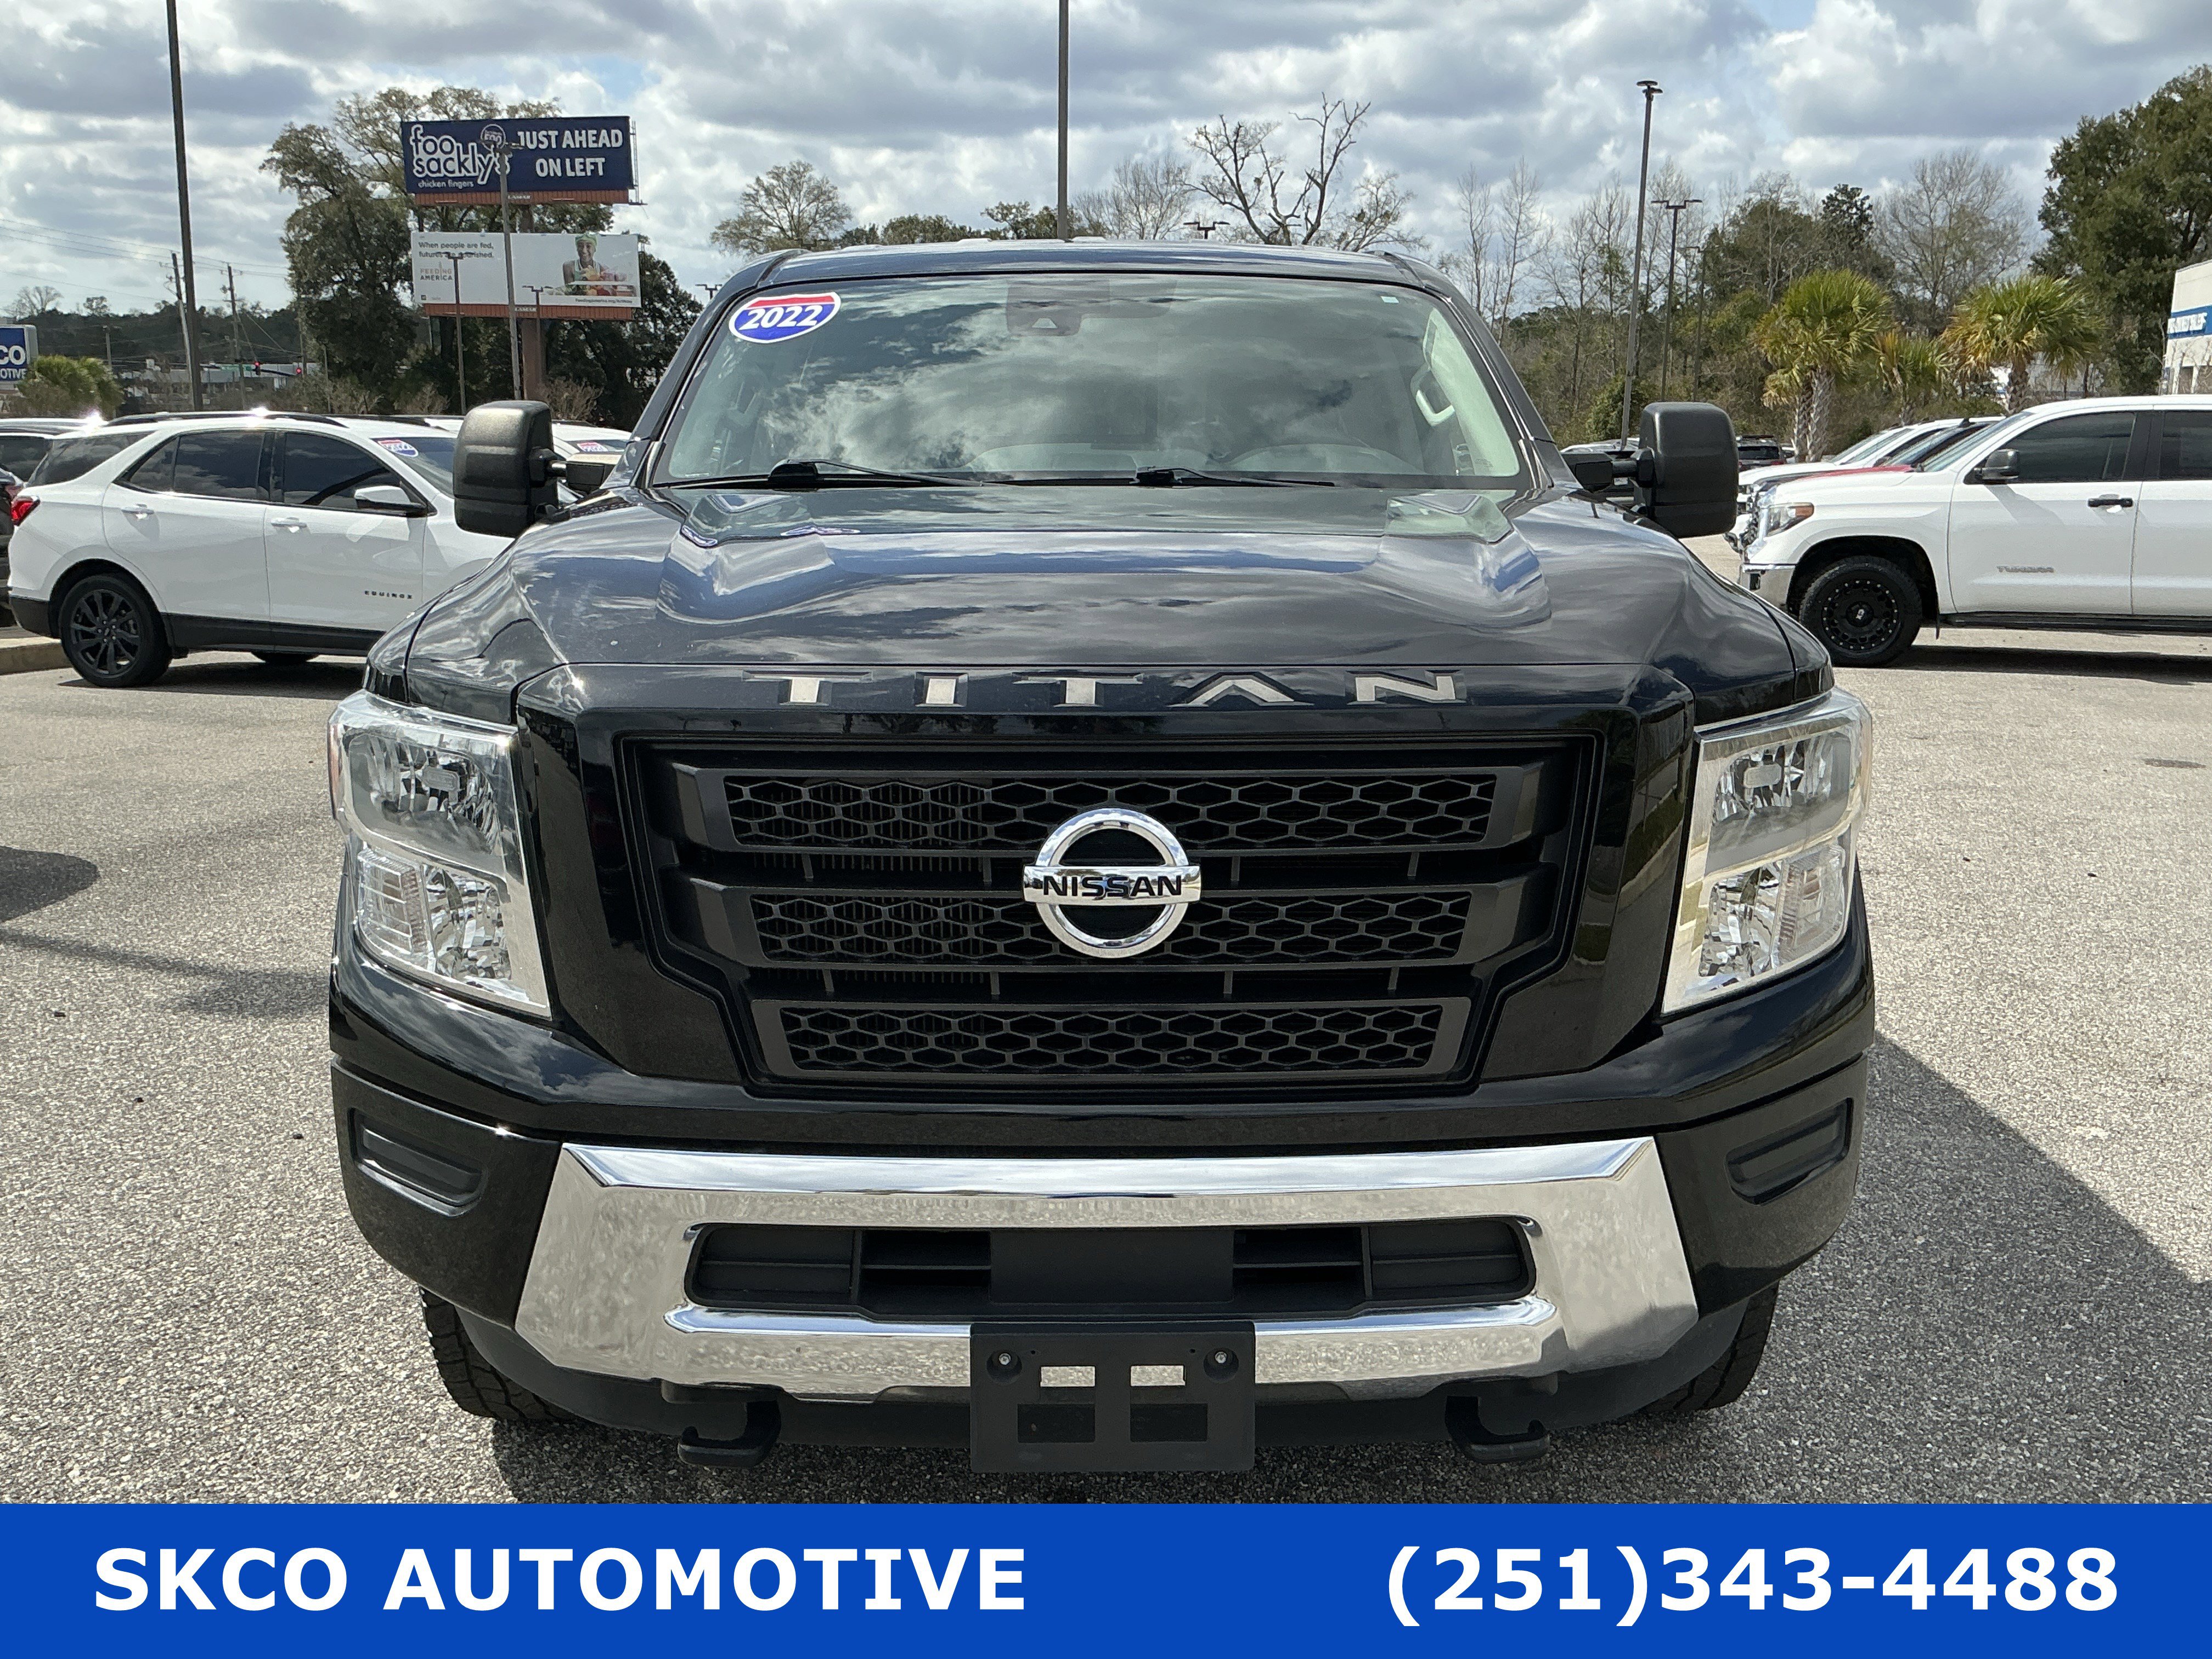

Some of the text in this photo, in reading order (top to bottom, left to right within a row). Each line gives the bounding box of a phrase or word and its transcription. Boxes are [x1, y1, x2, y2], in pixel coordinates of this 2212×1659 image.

[410, 124, 455, 156] foo
[516, 131, 558, 149] JUST
[562, 129, 623, 149] AHEAD
[535, 157, 606, 177] ON LEFT
[418, 179, 474, 189] chicken fingers
[440, 241, 465, 250] people
[738, 305, 823, 330] 2022
[364, 590, 413, 600] EQUINOX
[743, 670, 1466, 707] TITAN
[1043, 875, 1182, 898] NISSAN
